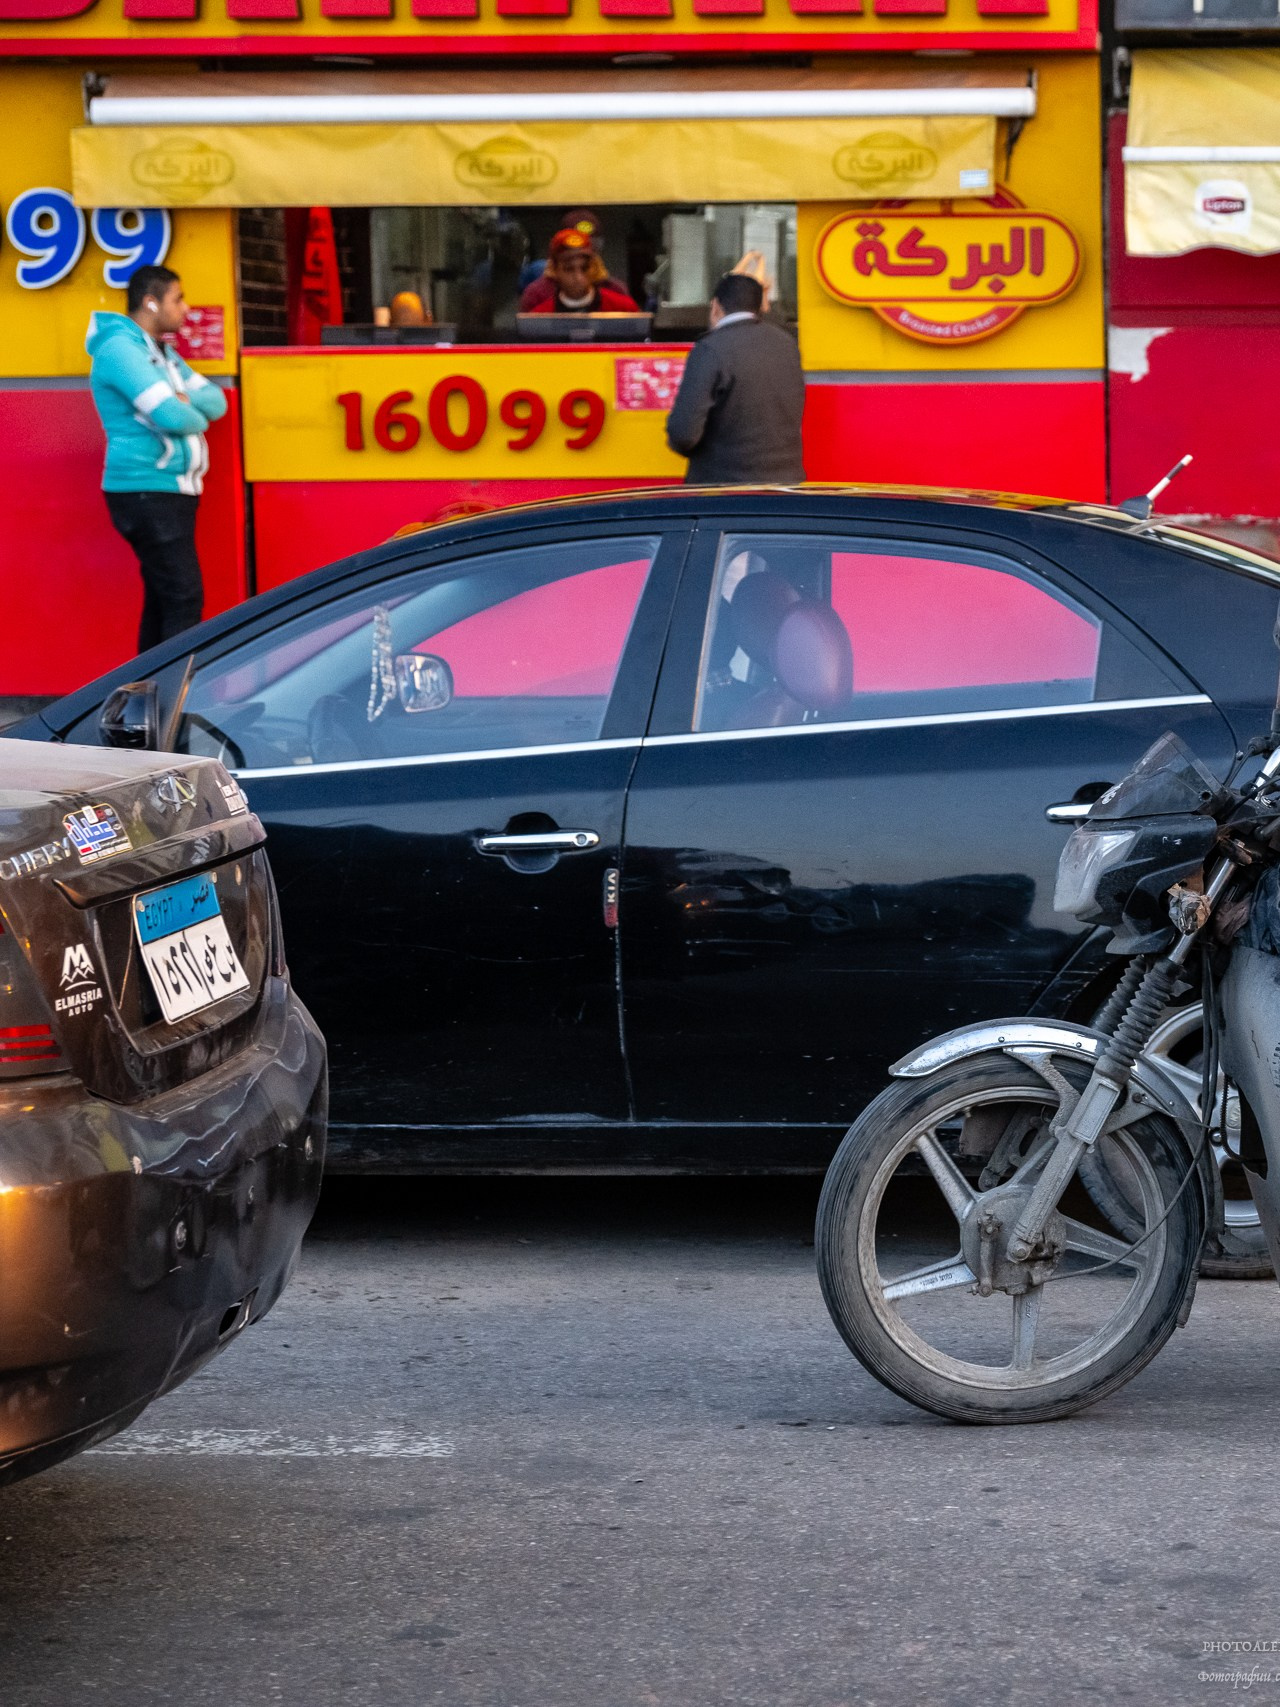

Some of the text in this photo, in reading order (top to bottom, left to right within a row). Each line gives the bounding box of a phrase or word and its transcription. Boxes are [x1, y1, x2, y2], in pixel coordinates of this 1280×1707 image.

[1204, 198, 1243, 211] Lipton
[853, 221, 1044, 294] البركة
[336, 375, 605, 452] 16099
[0, 837, 71, 880] CHERY
[144, 896, 173, 930] EGYPT
[55, 987, 103, 1012] ELMASRIA
[68, 1002, 93, 1017] AUTO
